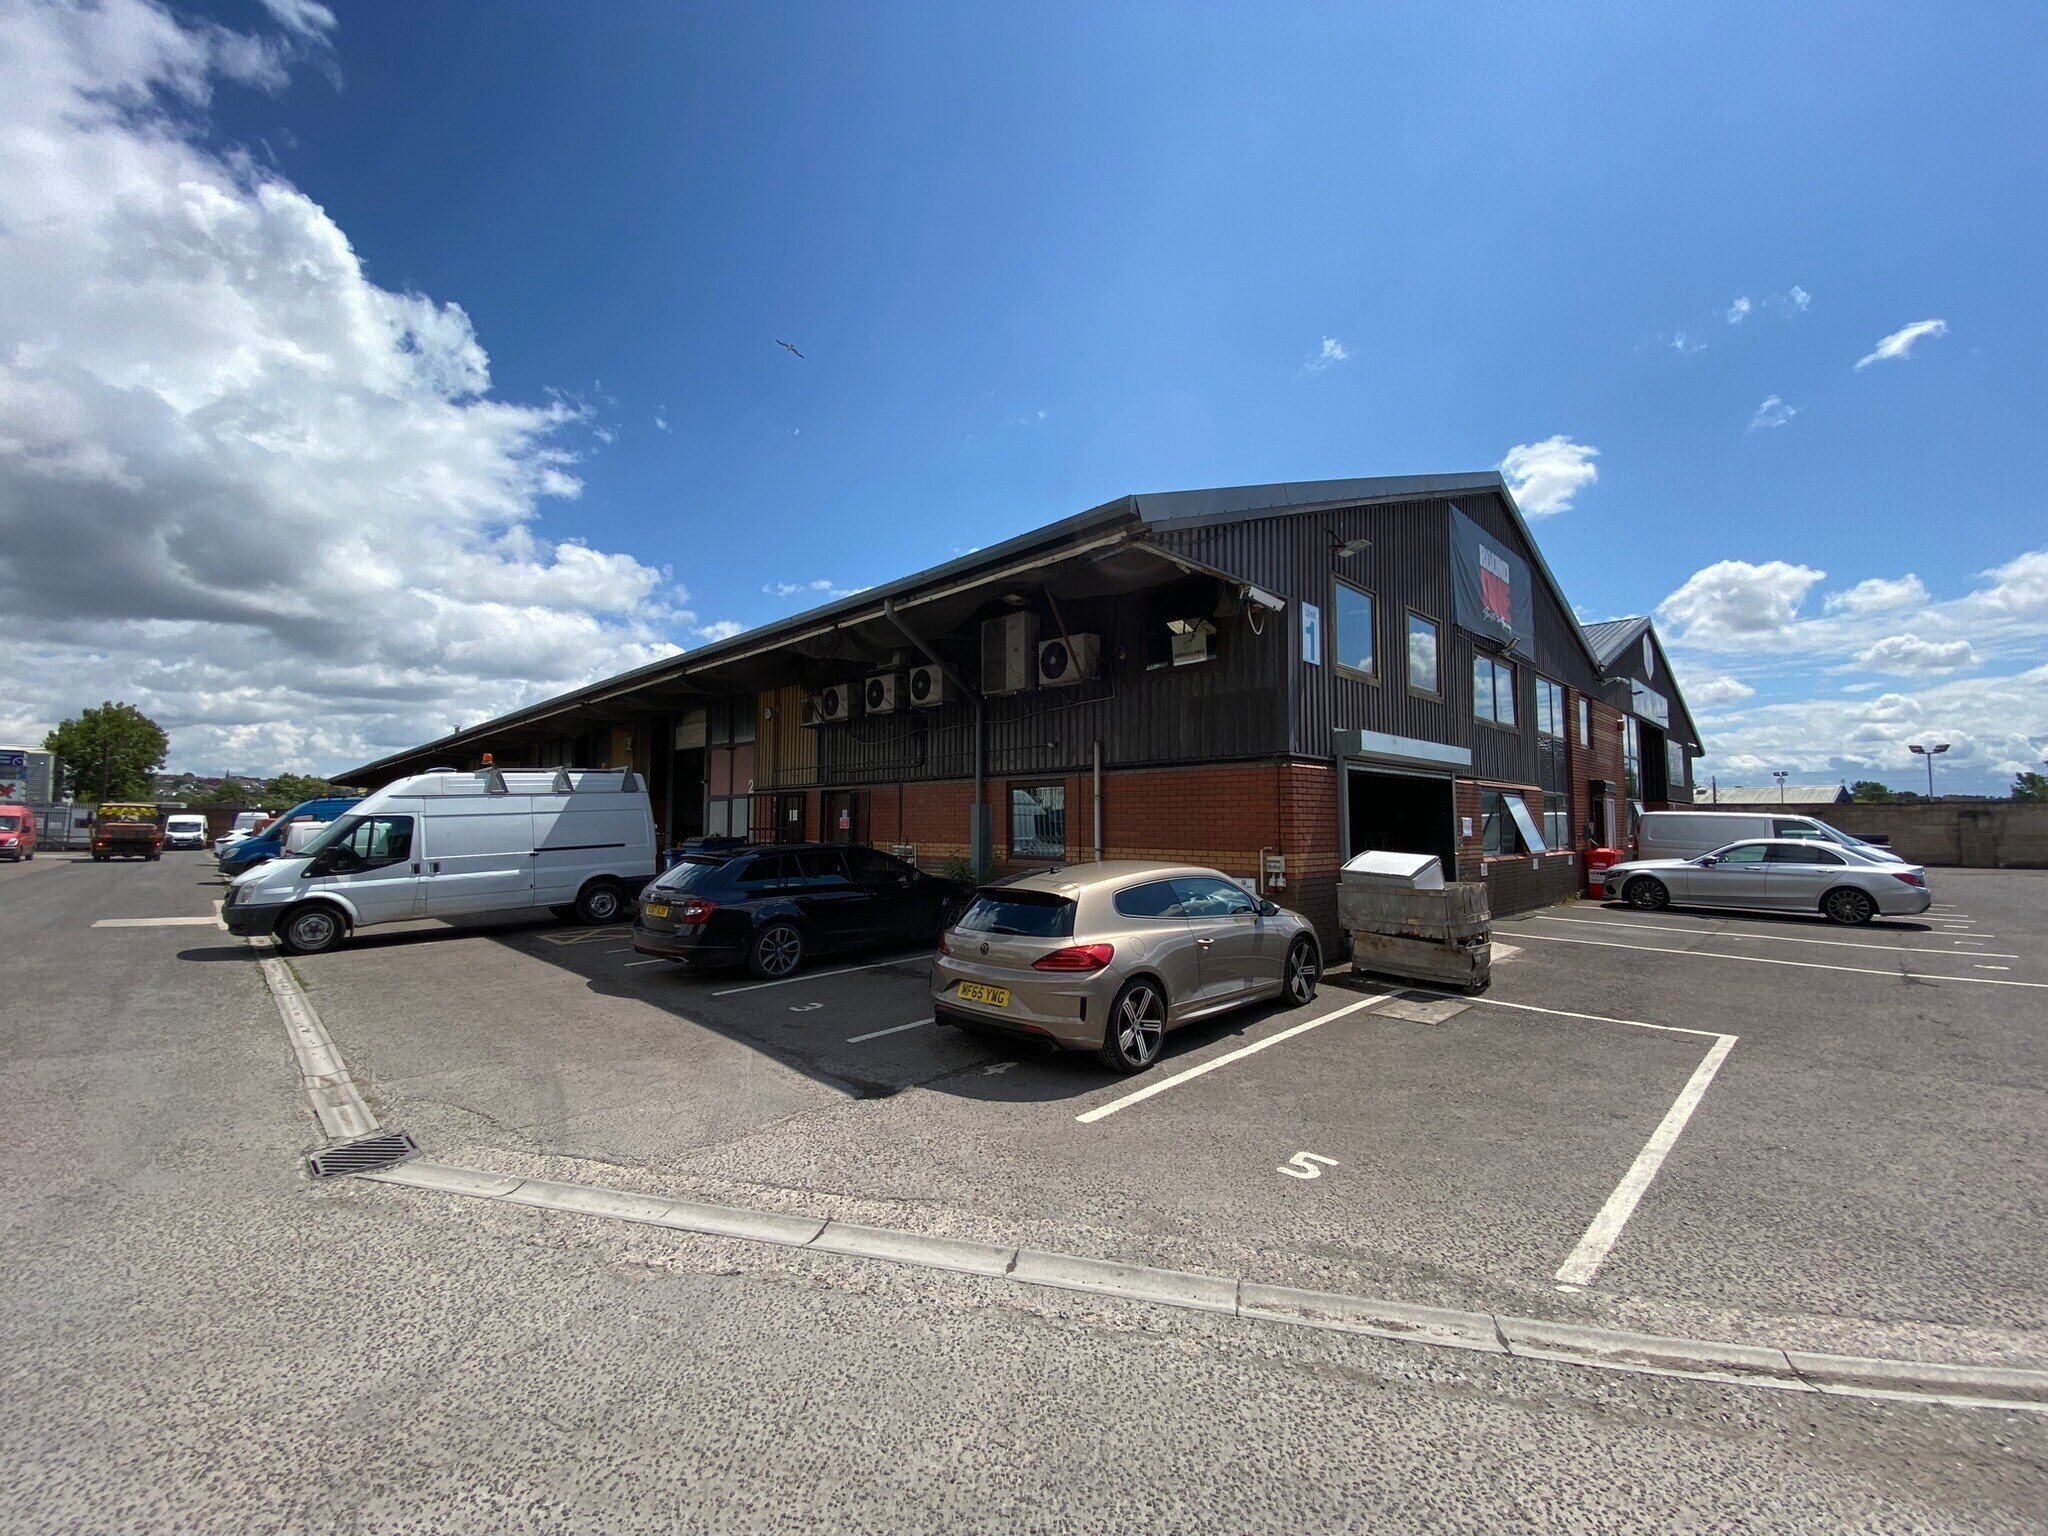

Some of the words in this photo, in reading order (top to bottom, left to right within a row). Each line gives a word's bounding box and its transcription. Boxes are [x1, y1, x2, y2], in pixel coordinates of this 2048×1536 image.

[1305, 607, 1317, 620] Unit
[1306, 621, 1316, 661] 1
[748, 779, 754, 794] 2
[1276, 1151, 1339, 1179] 5
